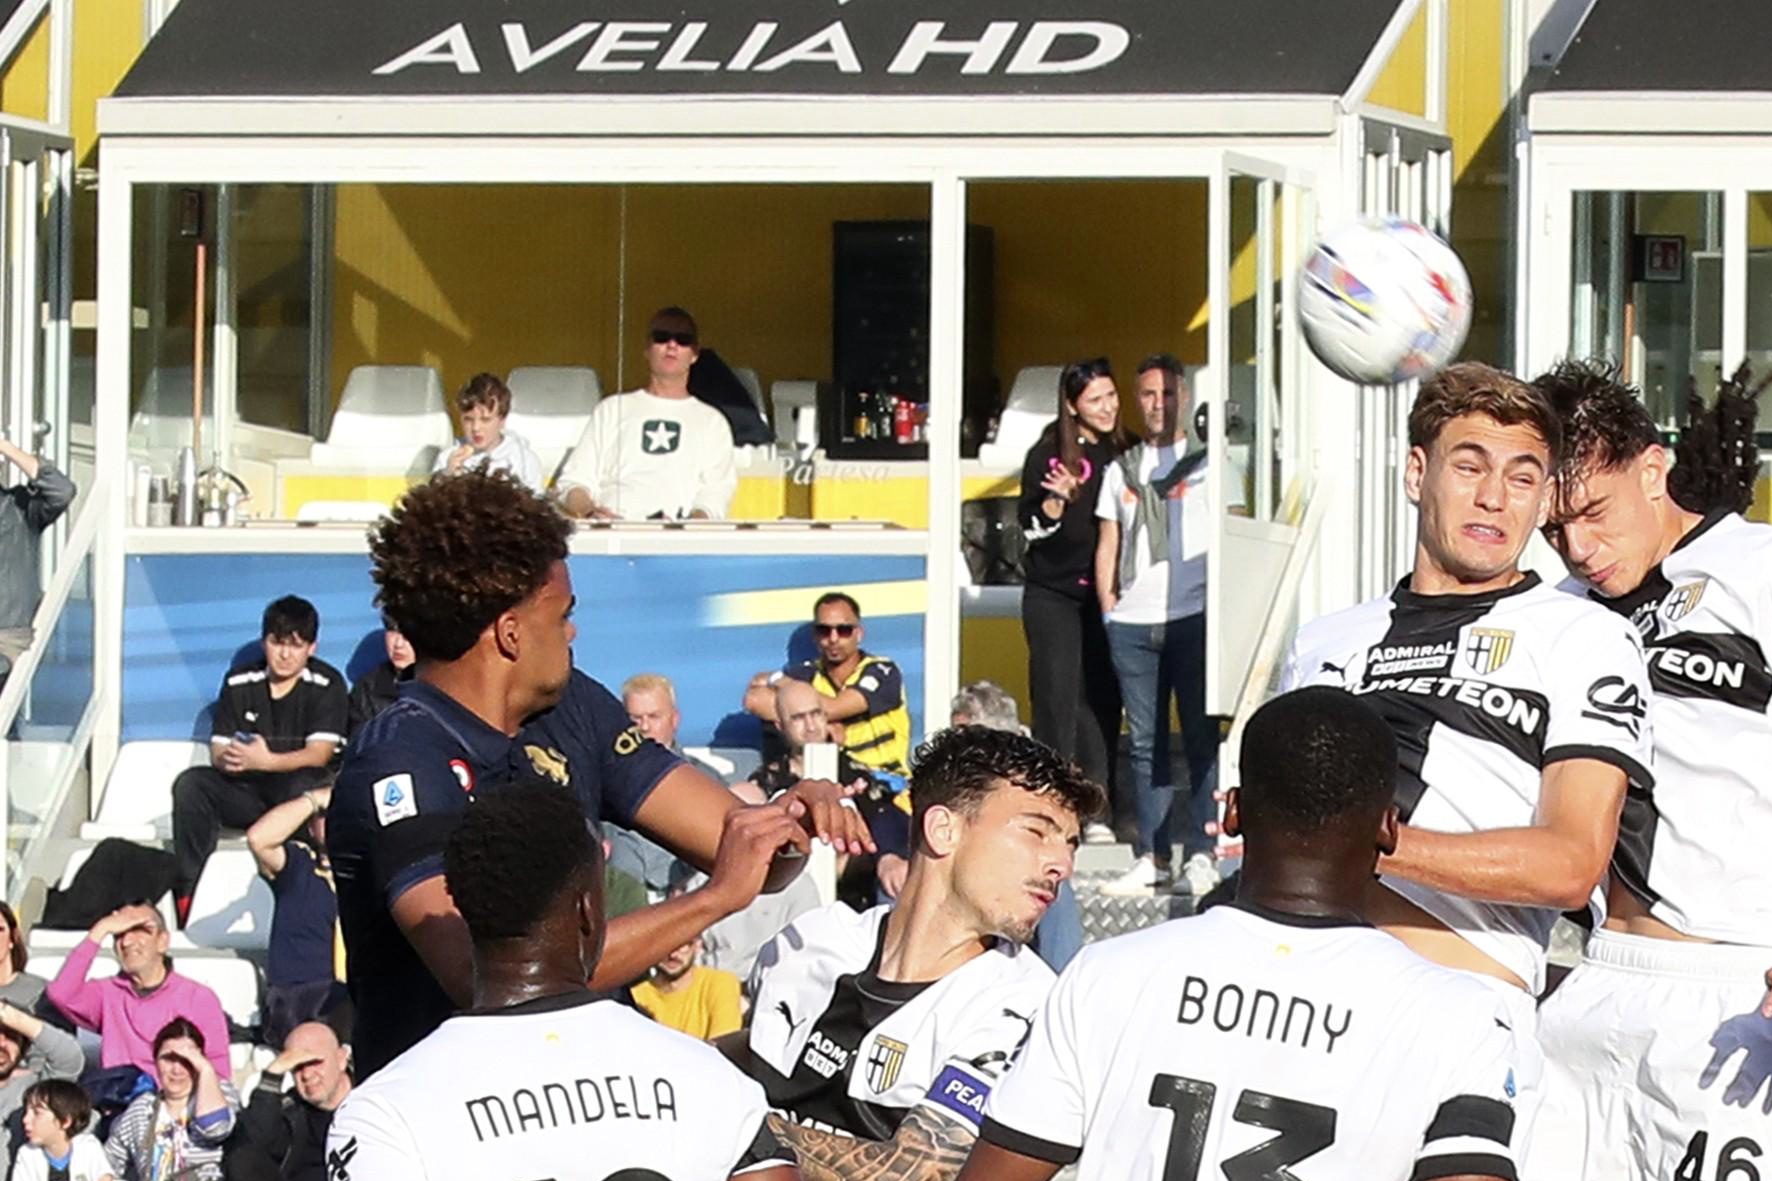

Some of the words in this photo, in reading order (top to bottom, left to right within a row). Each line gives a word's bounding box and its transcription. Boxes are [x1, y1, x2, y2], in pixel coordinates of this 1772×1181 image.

[372, 22, 862, 74] AVELIA
[886, 22, 1130, 74] HD
[1368, 641, 1456, 664] ADMIRAL
[1177, 975, 1352, 1053] BONNY
[465, 1075, 677, 1141] MANDELA
